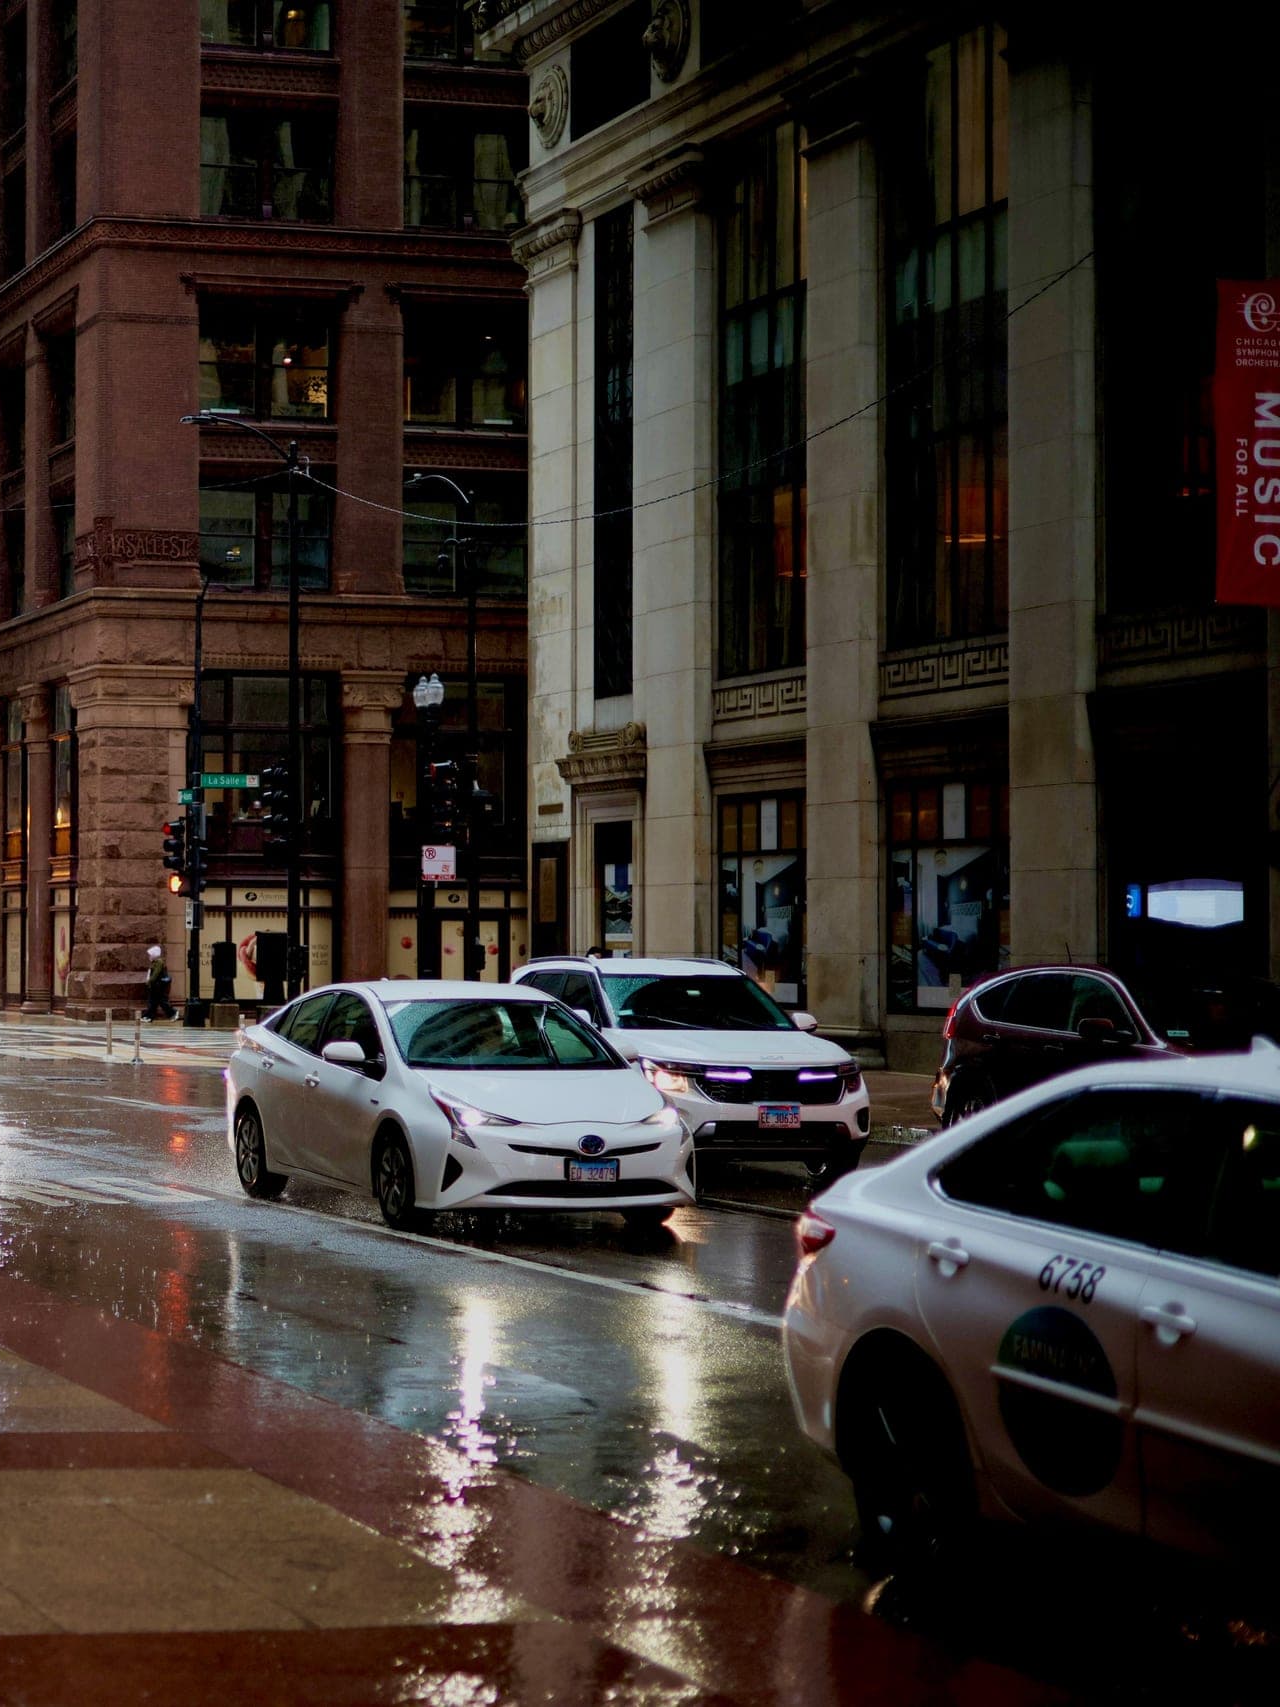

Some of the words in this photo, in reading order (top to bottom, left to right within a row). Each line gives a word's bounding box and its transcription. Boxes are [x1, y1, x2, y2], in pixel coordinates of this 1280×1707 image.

[1235, 337, 1280, 347] CHICAG
[1235, 347, 1280, 358] SYMPHON
[1235, 358, 1280, 368] ORCHESTR
[1235, 437, 1248, 476] FOR
[1253, 392, 1280, 566] MUSIC
[1235, 483, 1248, 517] ALL
[220, 776, 240, 785] Salle
[1038, 1254, 1107, 1304] 6758
